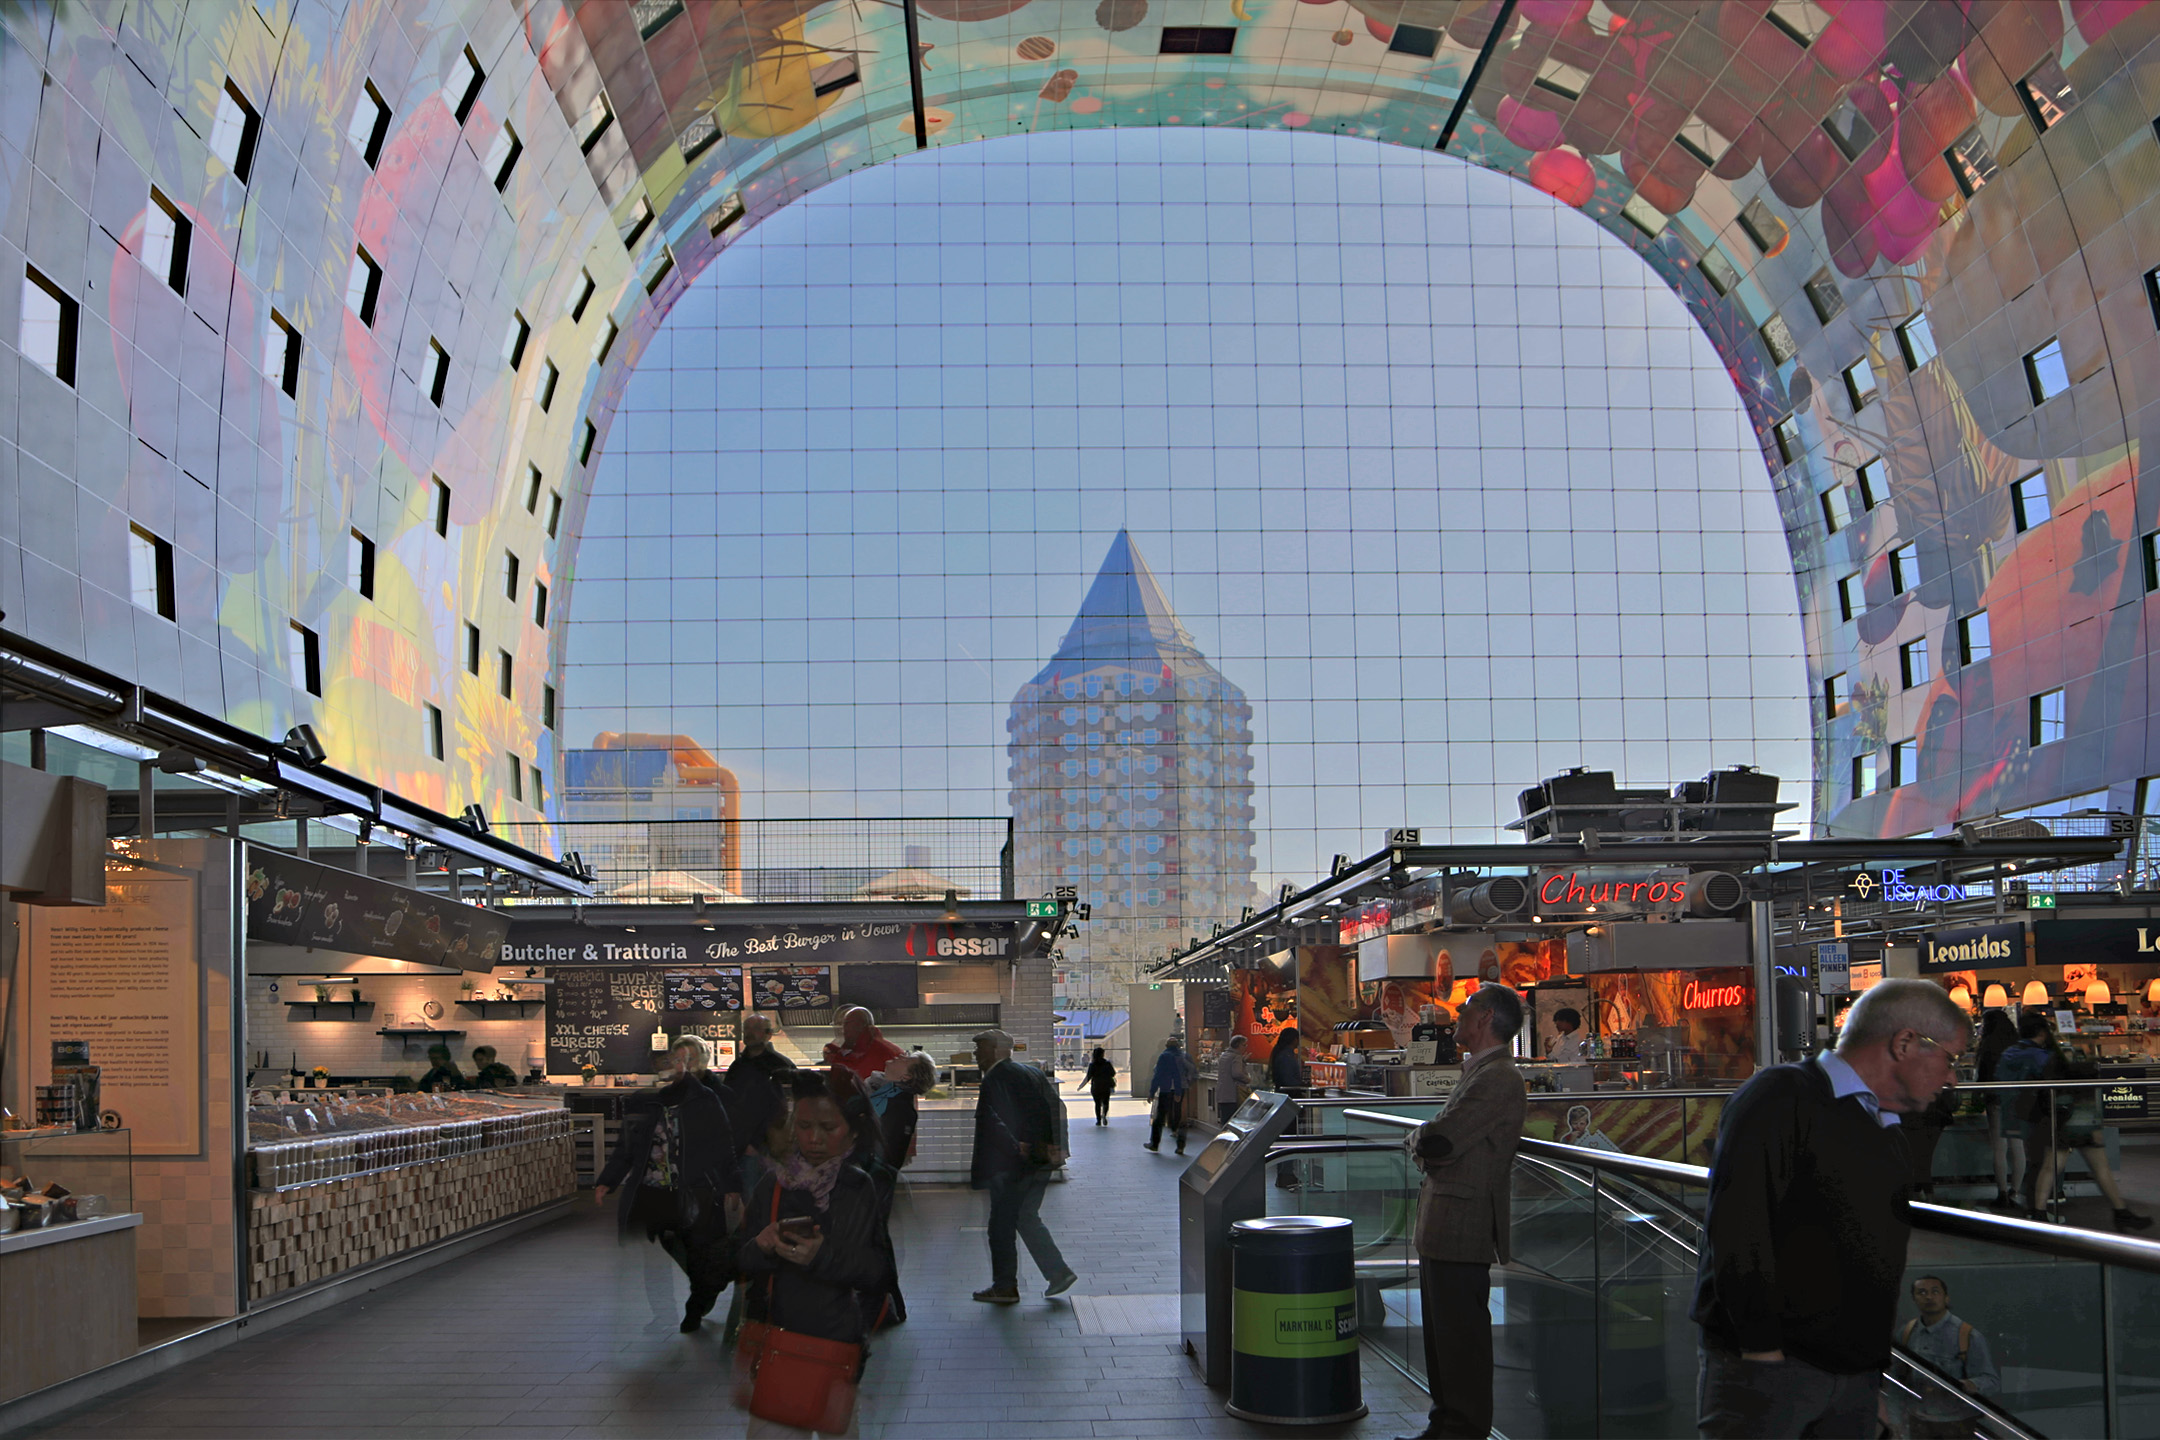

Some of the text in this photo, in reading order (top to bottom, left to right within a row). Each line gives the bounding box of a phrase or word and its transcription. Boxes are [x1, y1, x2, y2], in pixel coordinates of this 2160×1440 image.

[1393, 829, 1418, 843] 49
[1882, 868, 1905, 884] DE
[1056, 887, 1076, 897] 25
[1541, 872, 1687, 904] Churros
[1884, 884, 1966, 902] IJSSALON
[744, 934, 782, 955] Best
[783, 932, 837, 951] Burger
[841, 927, 856, 941] in
[501, 942, 687, 961] Butcher & Trattoria
[1819, 945, 1837, 954] HIER
[1928, 933, 2012, 964] Leonidas
[1819, 954, 1847, 963] ALLEEN
[1820, 963, 1847, 972] PINNEN
[609, 972, 646, 984] LAVA
[1684, 980, 1742, 1010] Churros
[555, 1023, 630, 1036] XXL CHEESE
[550, 1036, 606, 1049] BURGER
[2102, 1093, 2144, 1102] Leonidas
[1279, 1319, 1333, 1332] MARKTHAL IS
